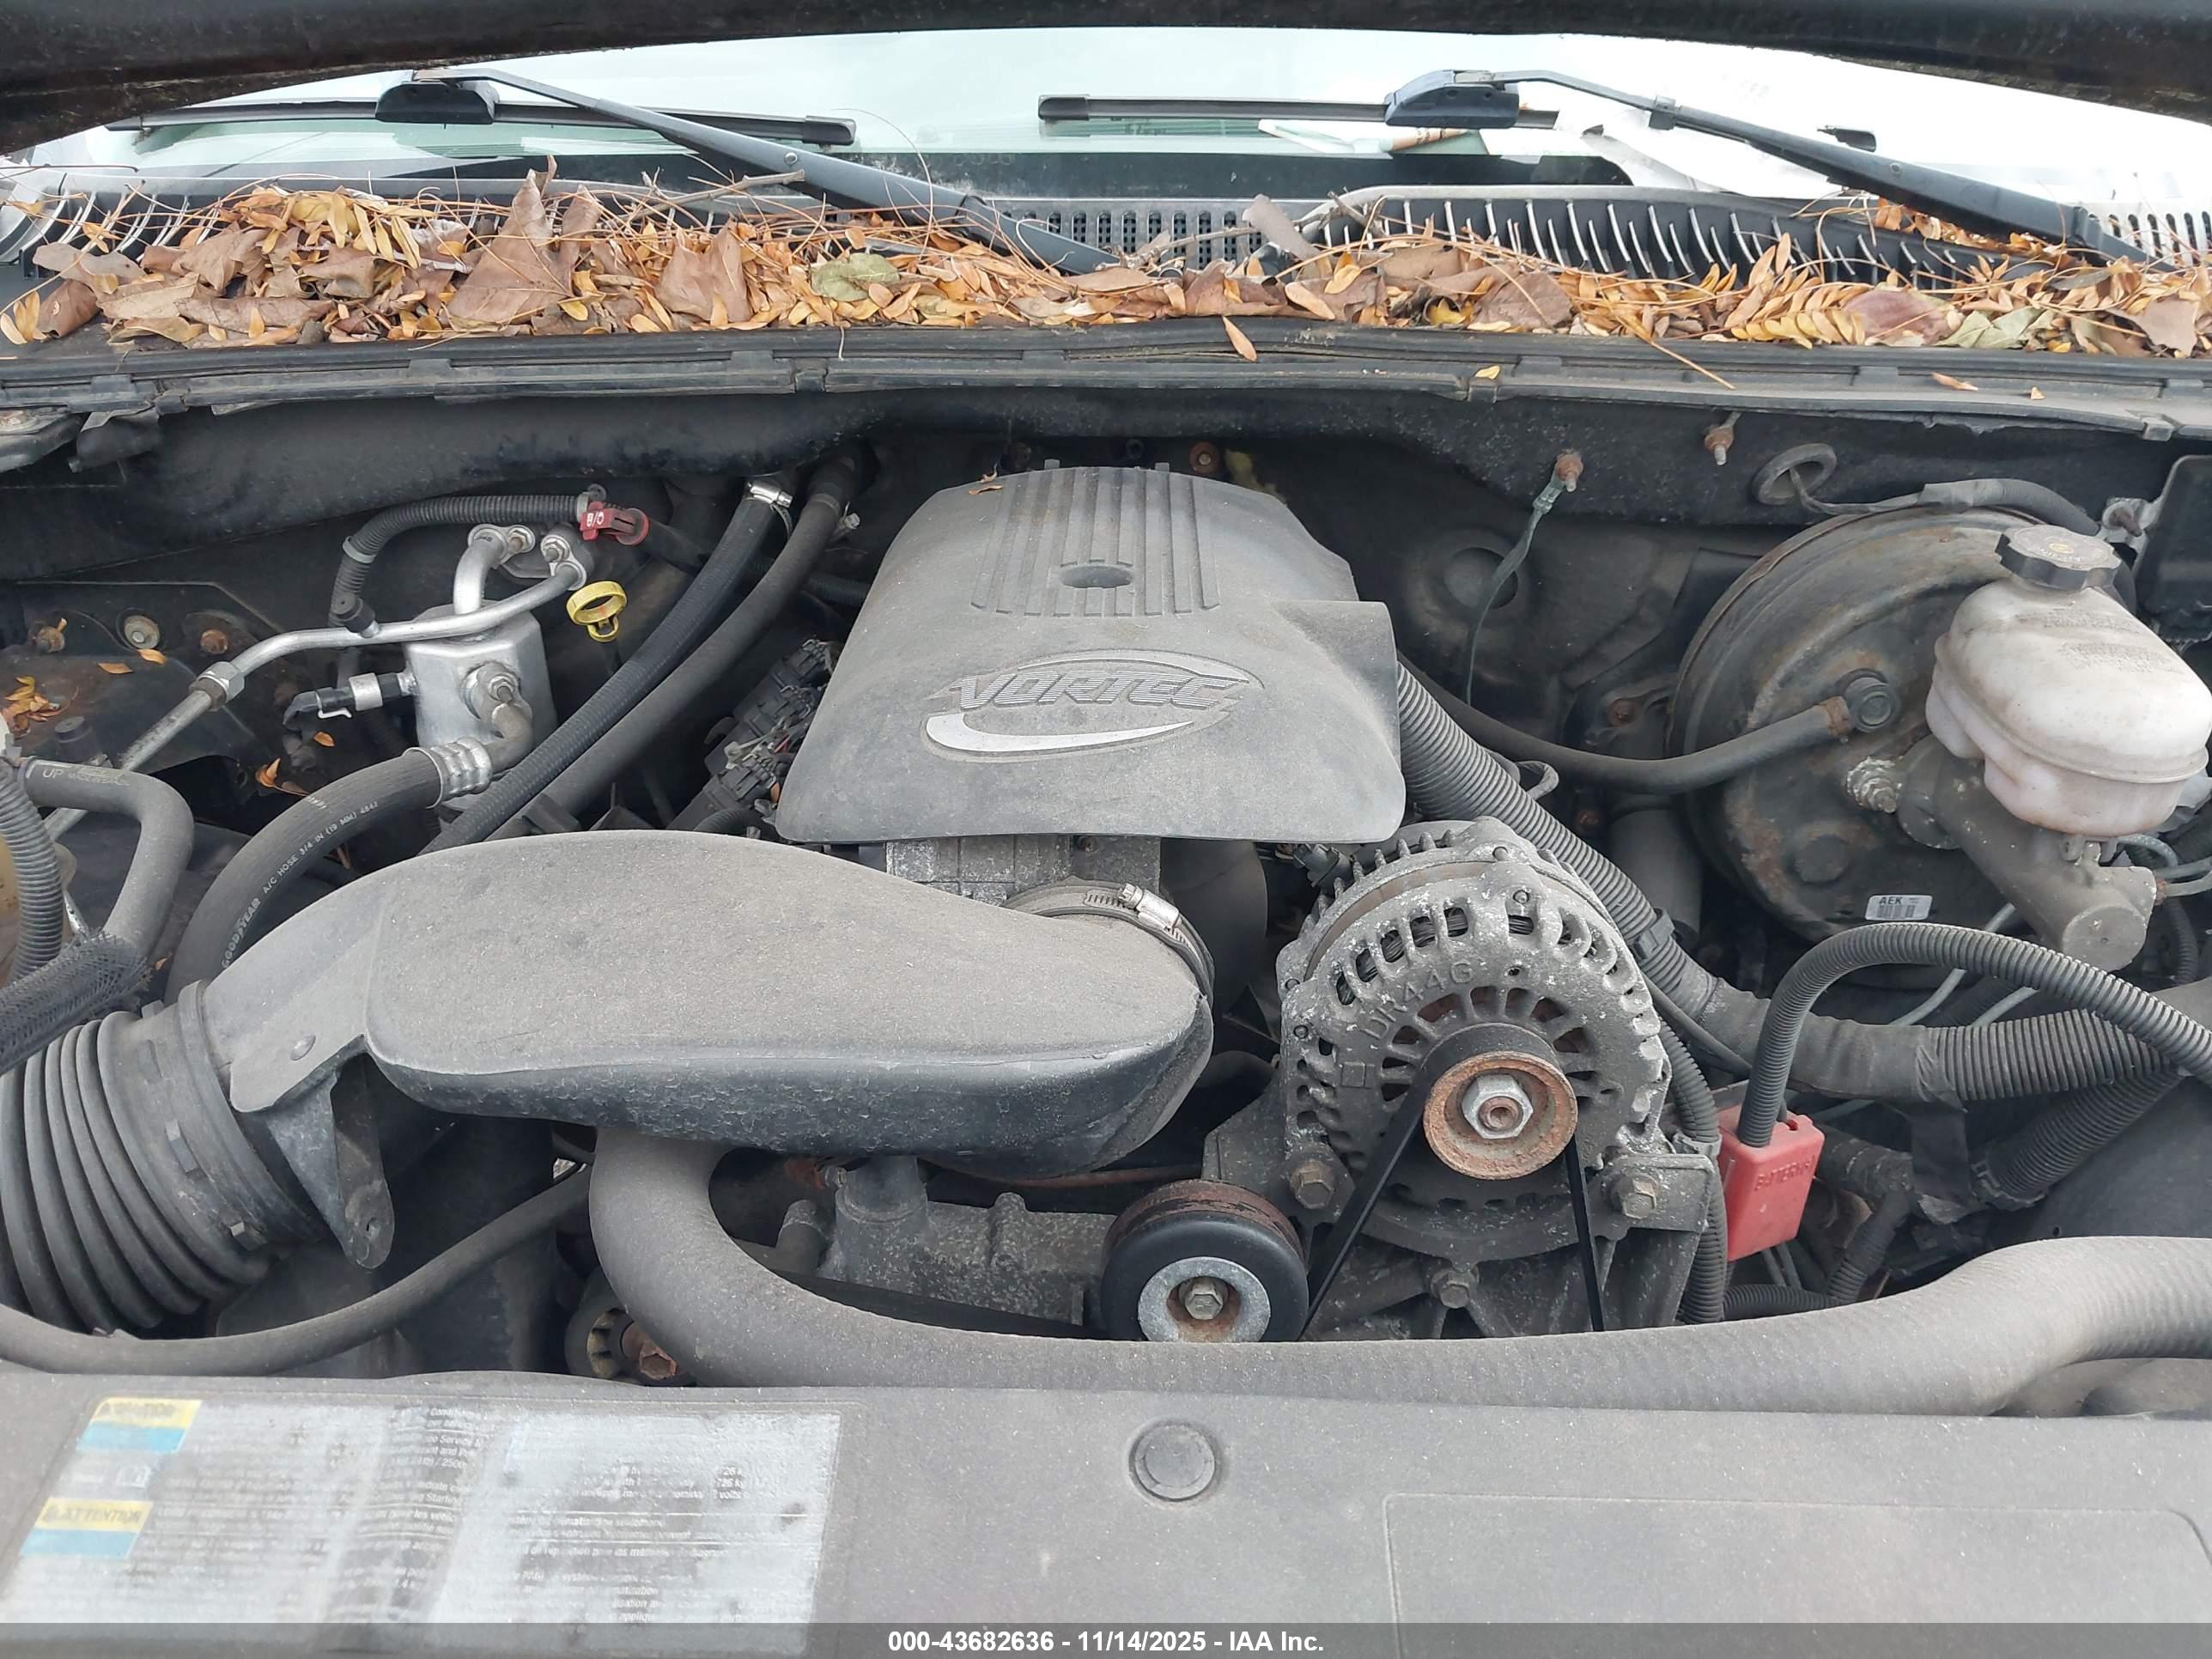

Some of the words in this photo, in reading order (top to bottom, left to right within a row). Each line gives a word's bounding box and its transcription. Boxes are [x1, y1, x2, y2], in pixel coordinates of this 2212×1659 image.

[950, 670, 1239, 710] VORTEC
[42, 768, 64, 779] UP
[222, 898, 261, 969] GOODYEAR
[262, 876, 277, 894] A/C
[277, 854, 299, 876] HOSE
[299, 842, 313, 855] 3/4
[315, 834, 325, 843] IN
[1879, 896, 1903, 905] AEK
